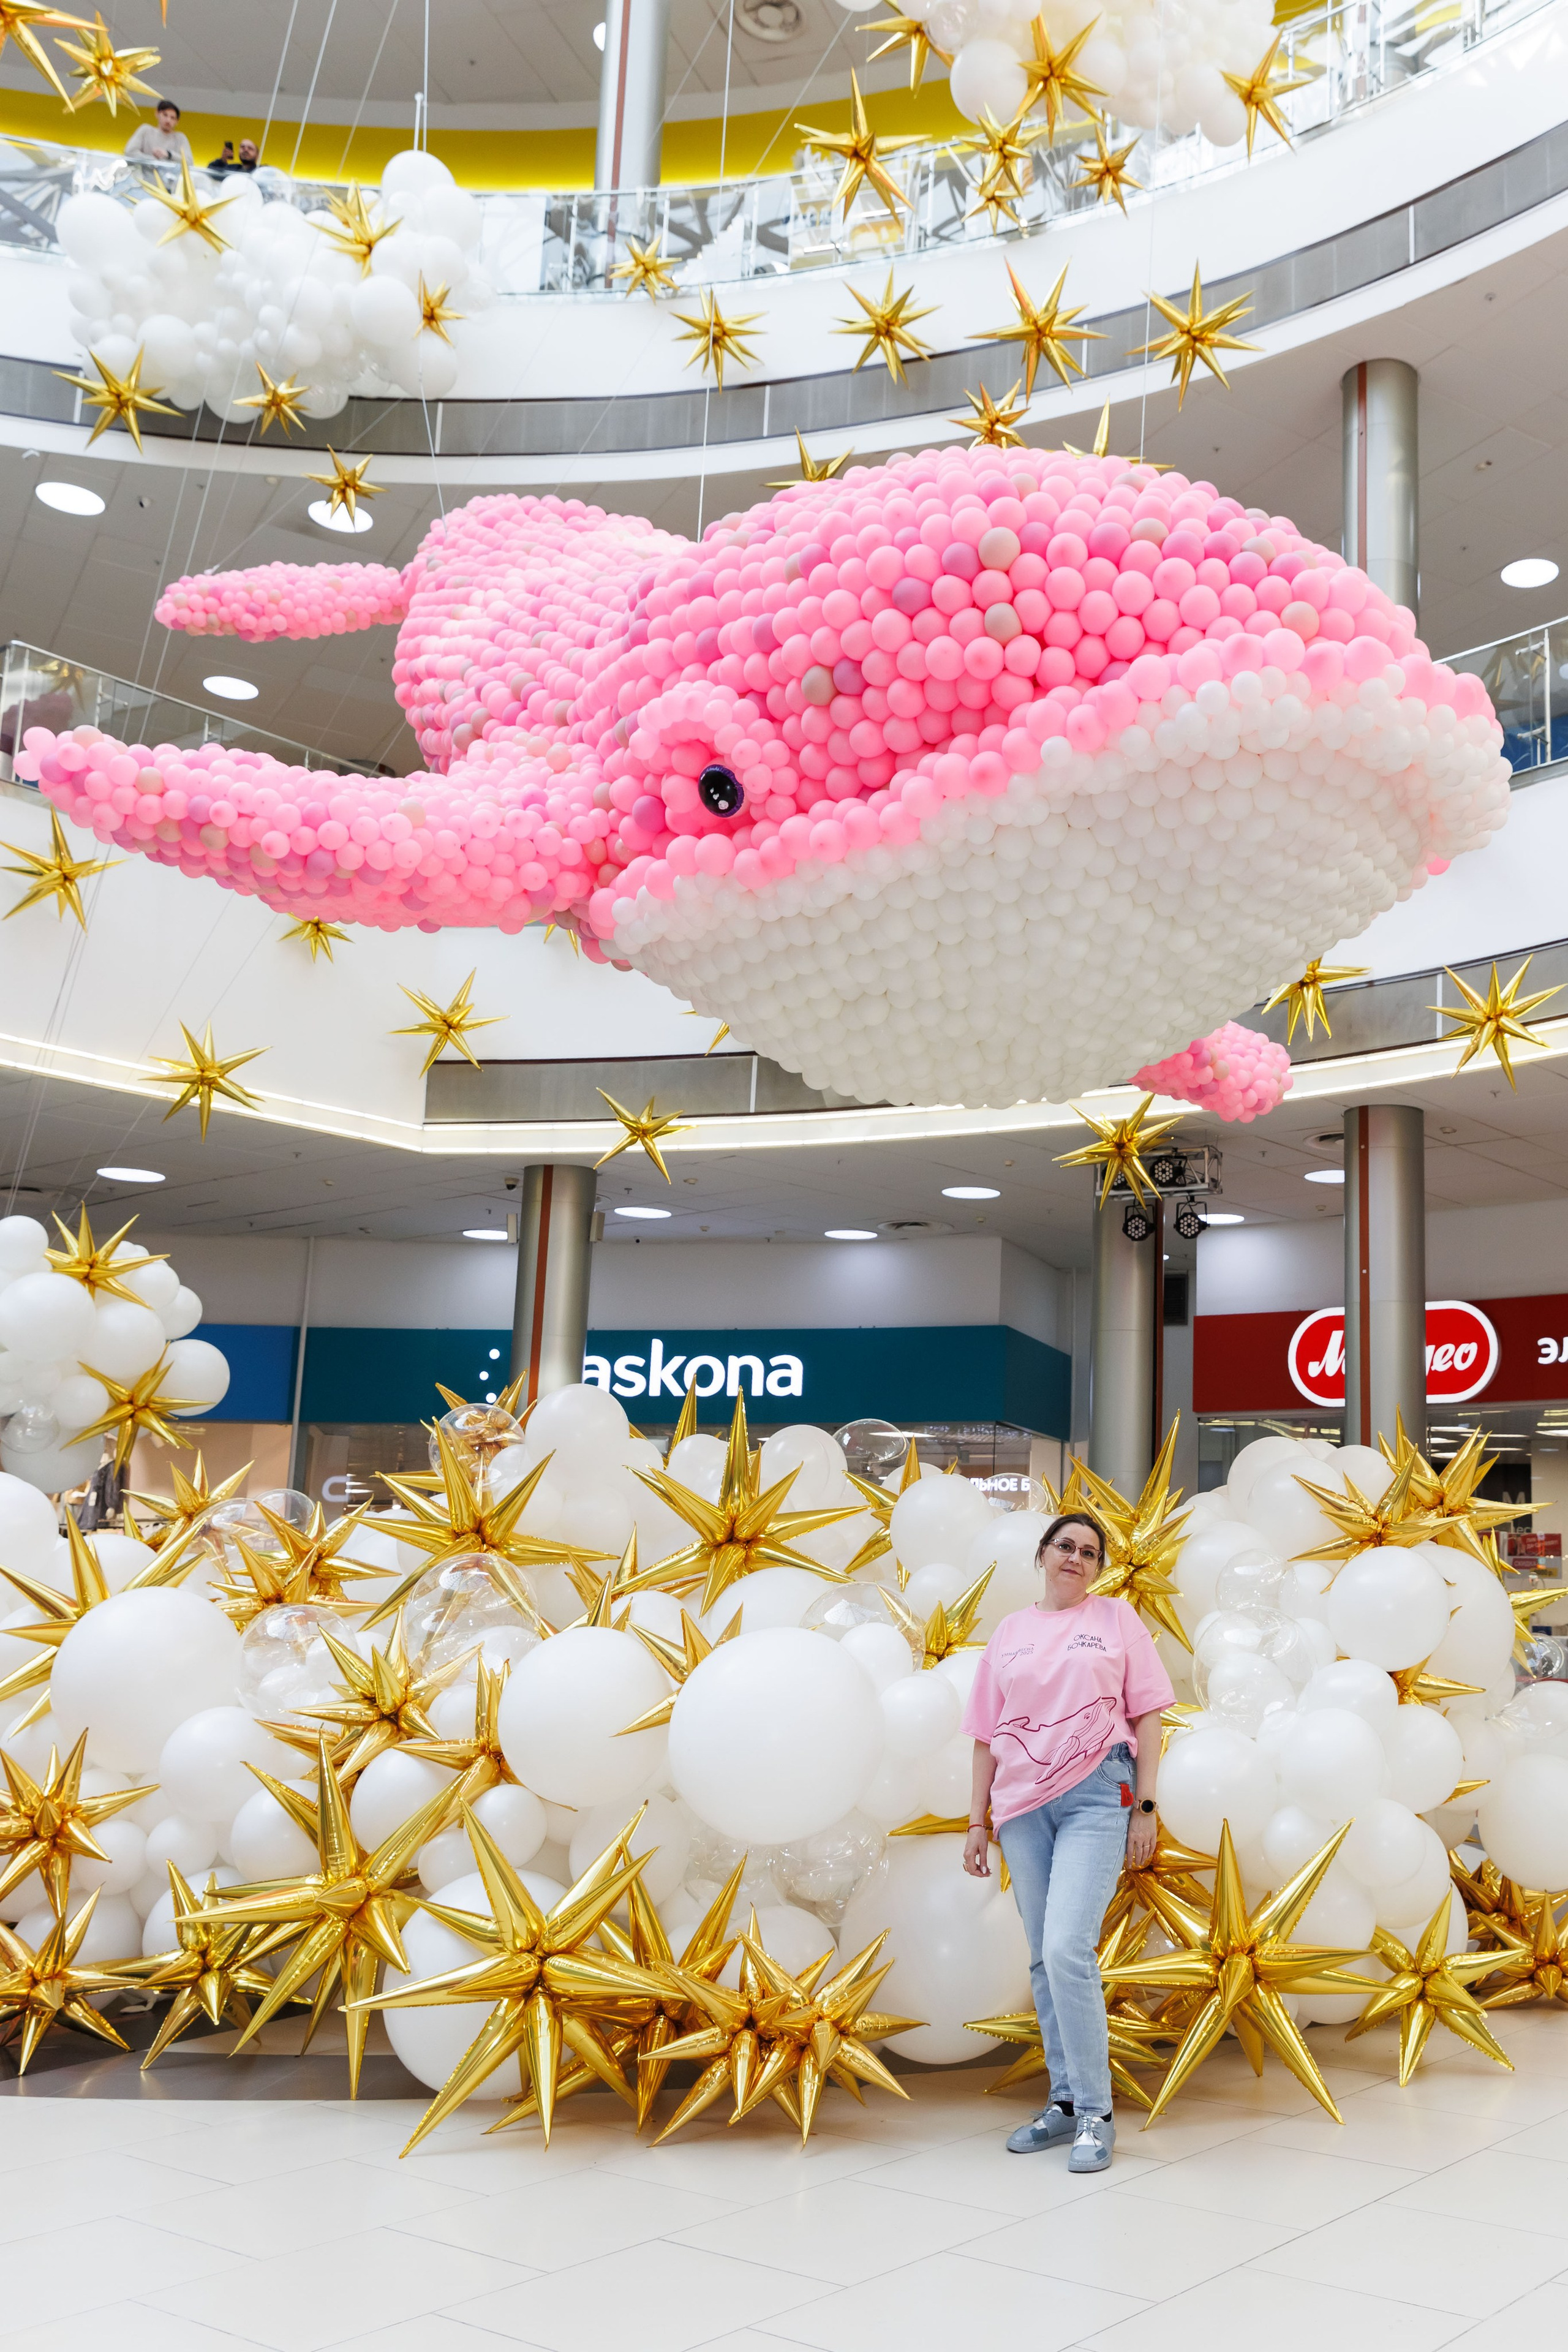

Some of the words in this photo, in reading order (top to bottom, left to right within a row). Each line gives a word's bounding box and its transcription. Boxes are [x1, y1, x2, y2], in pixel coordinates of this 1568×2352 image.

[581, 1338, 804, 1397] askona
[967, 1477, 1018, 1491] ЛЬНОЕ
[1073, 1634, 1102, 1643] ОКСАНА
[1067, 1642, 1107, 1652] БОЧКАРЕВА
